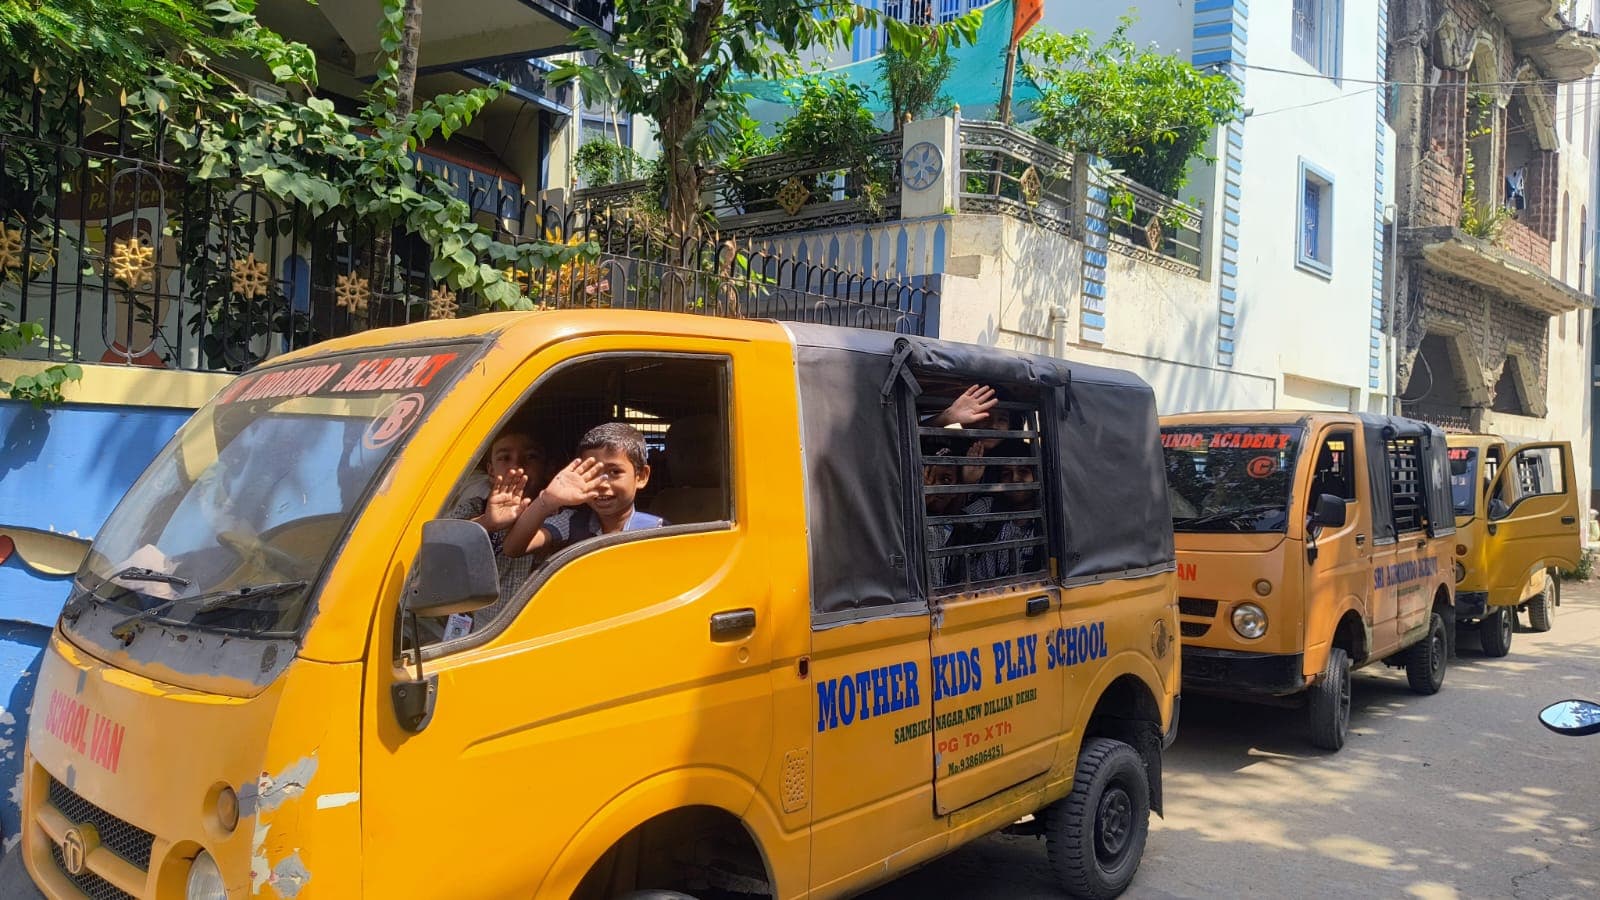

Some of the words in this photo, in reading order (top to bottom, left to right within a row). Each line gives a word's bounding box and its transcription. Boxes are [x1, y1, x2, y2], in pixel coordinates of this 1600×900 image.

[333, 352, 458, 393] ACADEMY
[1209, 433, 1292, 449] ACADEMY
[1177, 564, 1197, 582] AN
[816, 660, 920, 732] MOTHER
[932, 647, 982, 701] KIDS
[992, 633, 1038, 685] PLAY
[1046, 621, 1108, 671] SCHOOL
[45, 688, 90, 756] SCHOOL
[90, 712, 126, 775] VAN
[894, 718, 933, 744] SAMBIKA
[937, 737, 959, 755] PG
[963, 731, 980, 748] To
